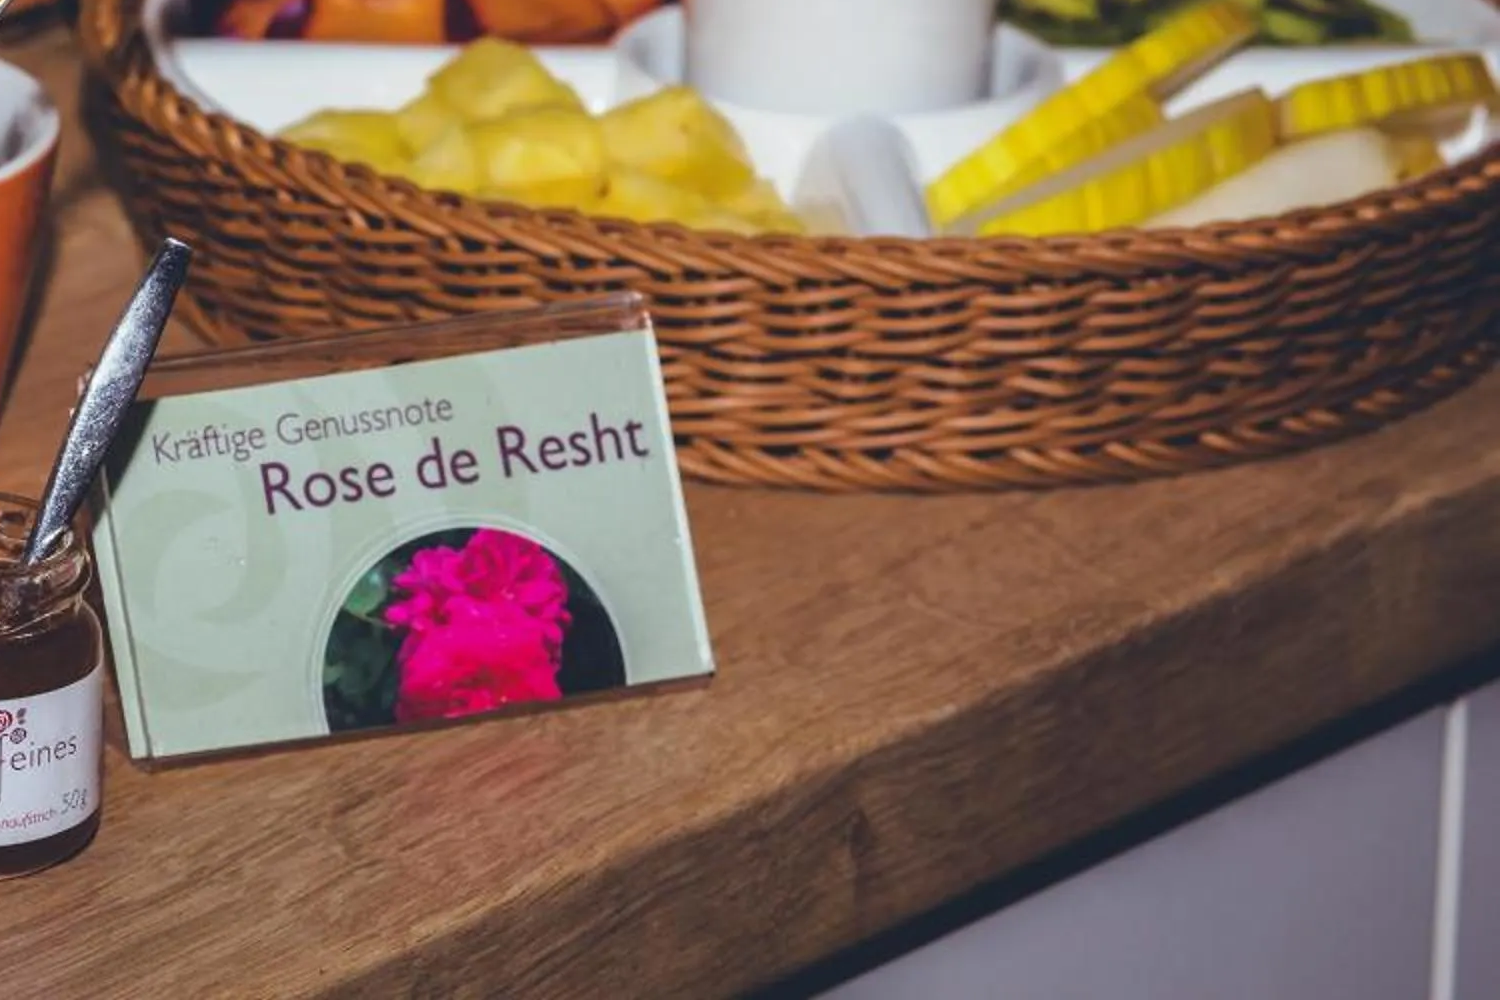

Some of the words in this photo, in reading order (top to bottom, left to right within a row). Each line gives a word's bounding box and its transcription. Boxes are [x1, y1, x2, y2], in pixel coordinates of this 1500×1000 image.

[152, 424, 267, 464] Kräftige
[276, 397, 455, 445] Genussnote
[260, 459, 398, 515] Rose
[416, 436, 481, 490] de
[496, 412, 650, 478] Resht
